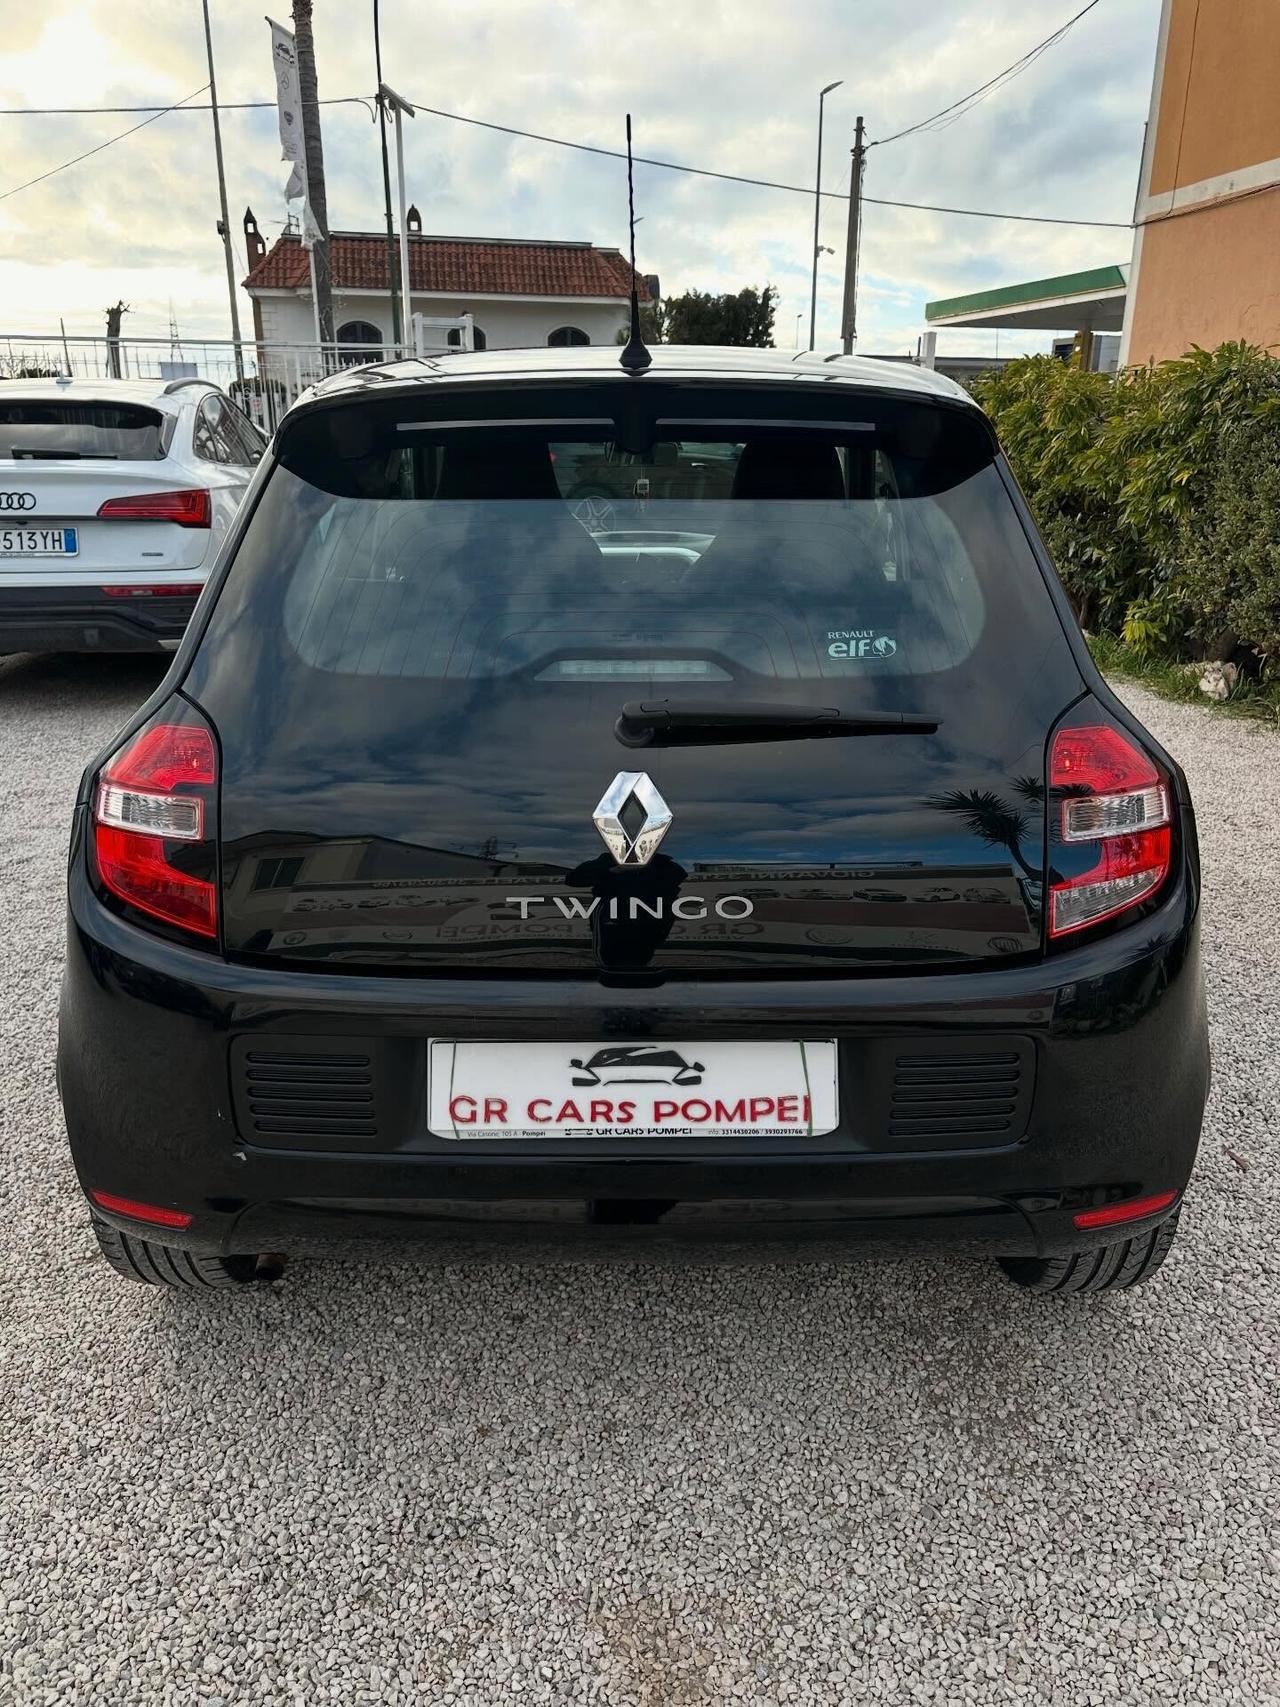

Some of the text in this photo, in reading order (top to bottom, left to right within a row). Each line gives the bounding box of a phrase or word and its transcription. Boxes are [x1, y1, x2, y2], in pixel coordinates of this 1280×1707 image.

[827, 630, 874, 639] RENAULT
[828, 639, 871, 657] elf
[505, 895, 754, 920] TWINGO
[449, 1095, 811, 1124] GR CARS POMPEI
[522, 1129, 546, 1138] Pompei
[596, 1128, 692, 1136] GR CARS POMPEI
